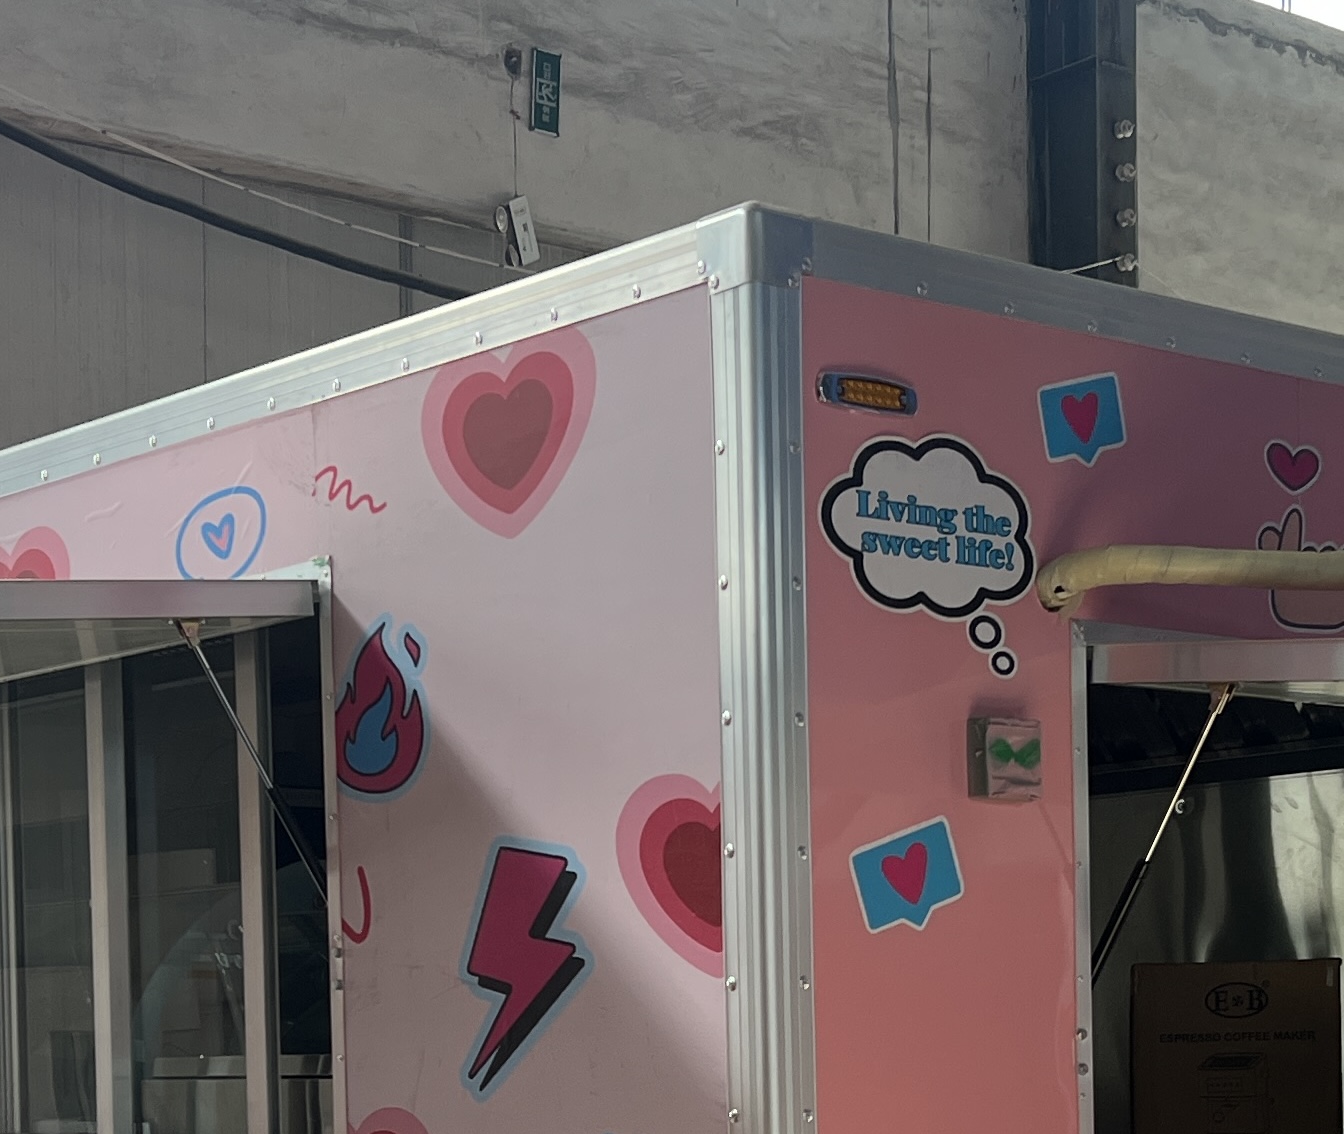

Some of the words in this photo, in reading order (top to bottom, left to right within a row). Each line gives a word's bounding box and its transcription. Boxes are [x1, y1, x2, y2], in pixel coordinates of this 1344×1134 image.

[856, 490, 958, 534] Living
[963, 505, 1012, 537] the
[861, 531, 950, 562] sweet
[955, 536, 1015, 571] life!
[1159, 1032, 1221, 1043] ESPRESSO
[1224, 1031, 1271, 1042] COFFEE
[1273, 1030, 1317, 1041] MAKER
